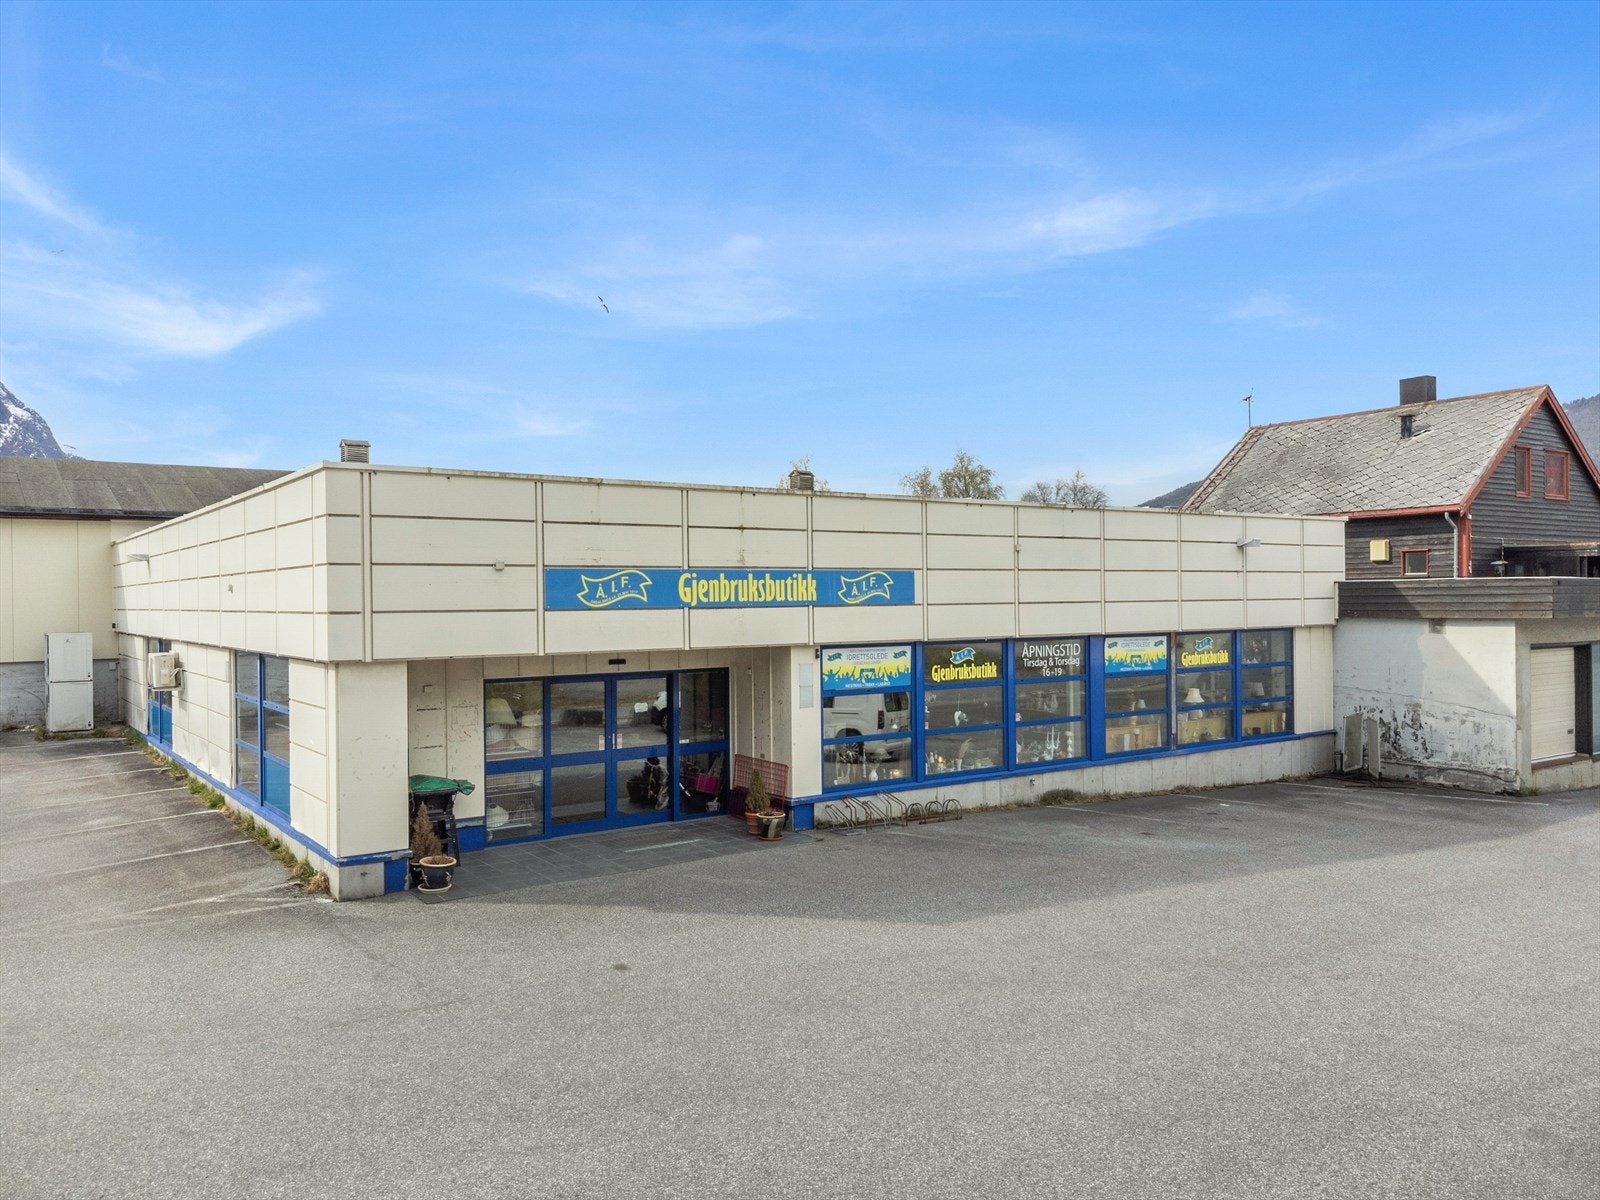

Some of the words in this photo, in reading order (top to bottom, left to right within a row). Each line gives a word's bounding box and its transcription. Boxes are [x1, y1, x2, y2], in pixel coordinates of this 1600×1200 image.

[678, 573, 817, 606] Gjenbruksbutikk
[846, 652, 889, 661] IDRETTSGLEDE
[1022, 642, 1080, 658] ÅPNINGSTID
[1023, 657, 1047, 669] Tirsdag
[1048, 657, 1054, 666] &
[1054, 656, 1080, 667] Torsdag
[1181, 650, 1229, 667] Gjenbruksbutikk
[931, 662, 997, 683] Gjenbruksbutikk
